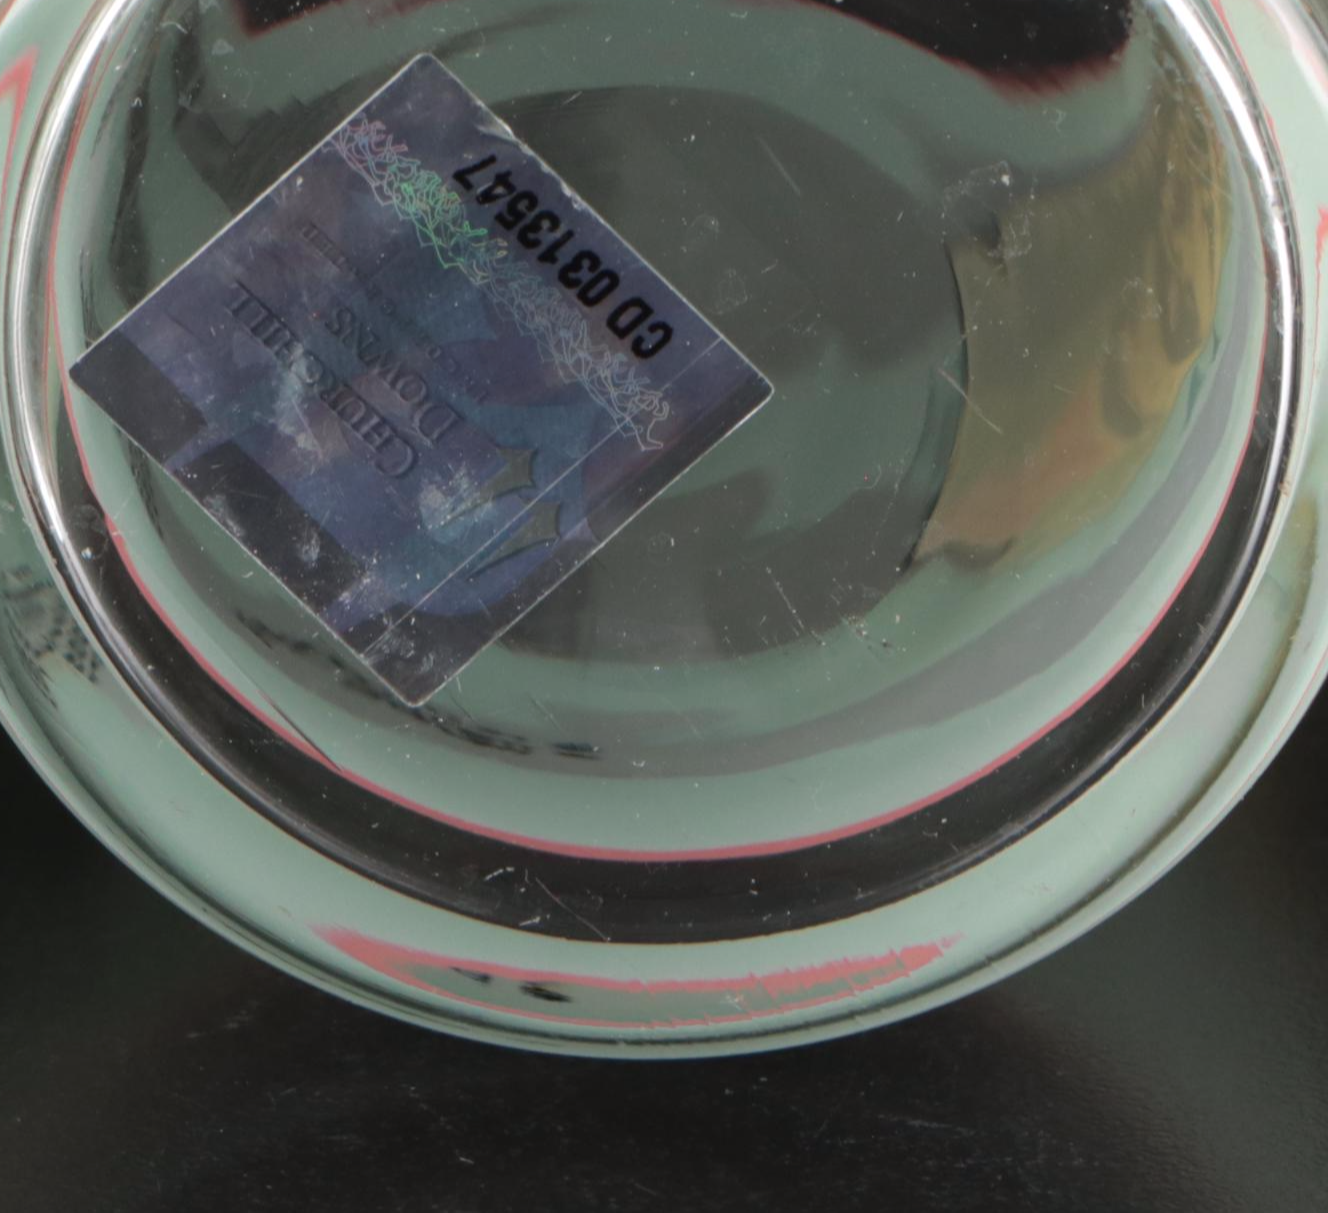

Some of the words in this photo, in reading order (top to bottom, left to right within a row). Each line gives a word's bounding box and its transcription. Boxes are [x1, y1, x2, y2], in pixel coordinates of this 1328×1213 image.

[451, 153, 621, 308] 0313547
[324, 304, 464, 449] DOWNS
[606, 296, 675, 360] CD
